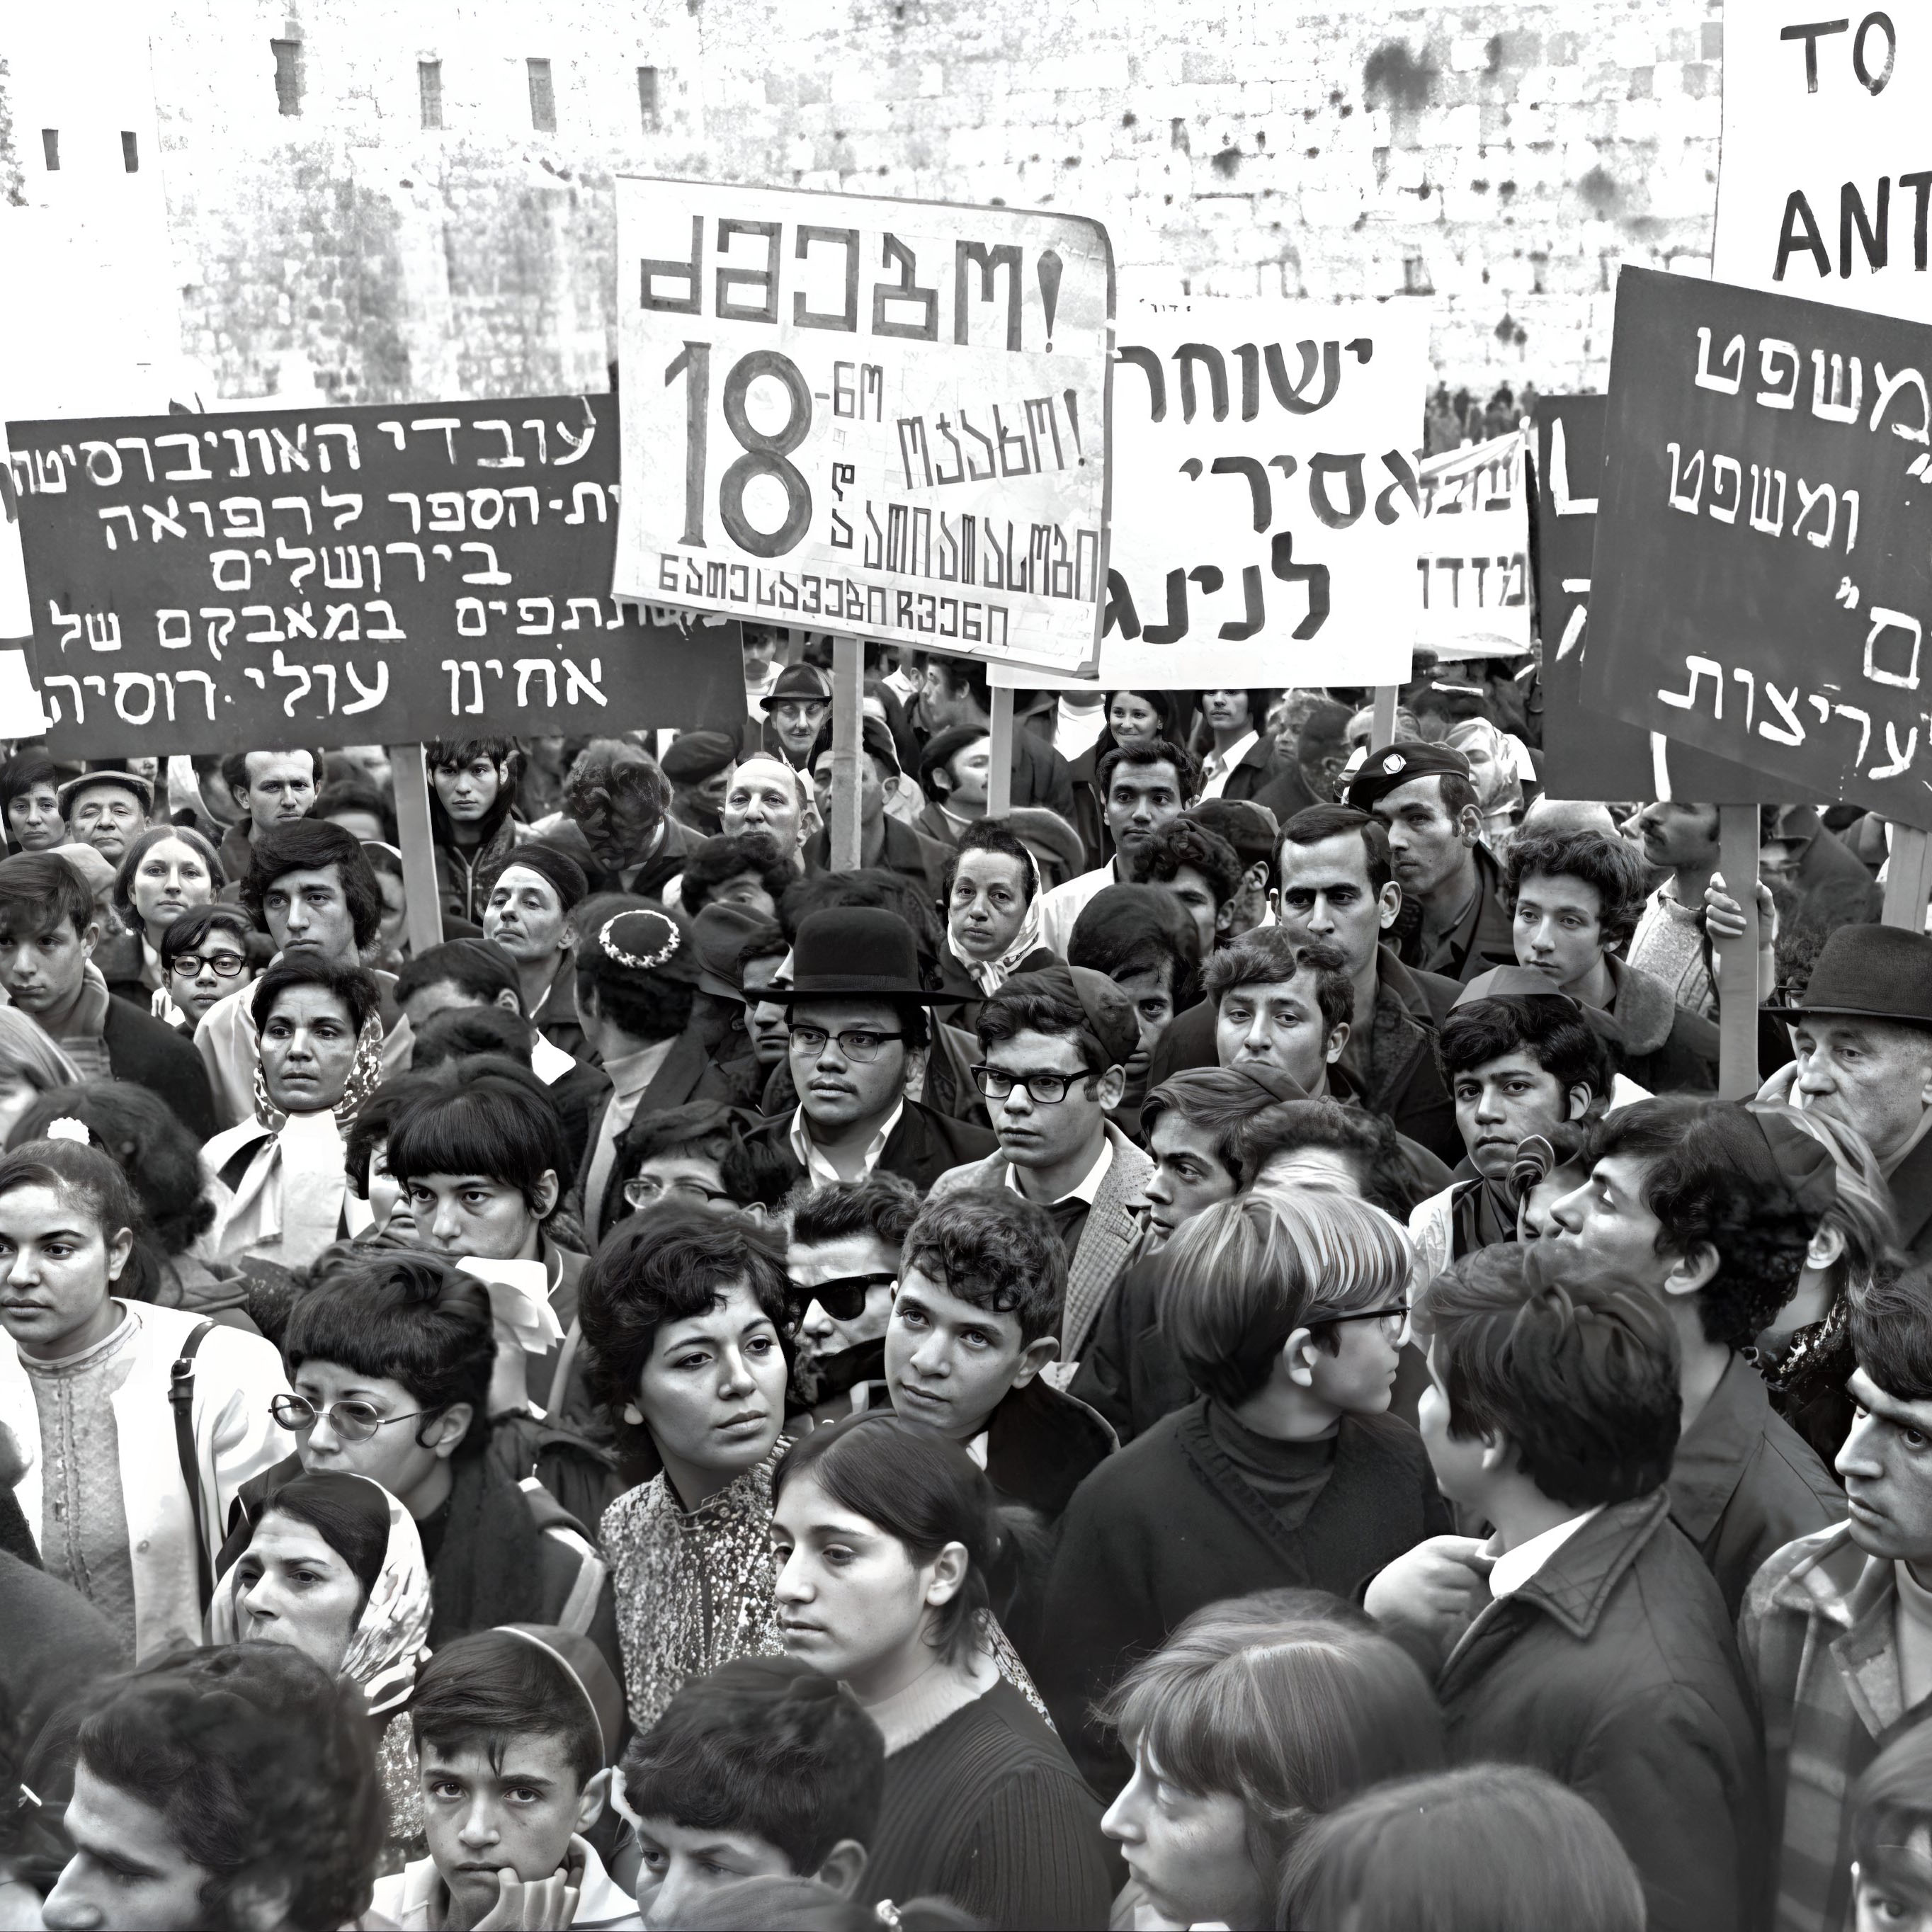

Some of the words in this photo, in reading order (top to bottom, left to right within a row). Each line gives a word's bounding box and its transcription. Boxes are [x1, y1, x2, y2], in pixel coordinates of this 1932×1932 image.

[1780, 11, 1896, 96] TO
[1772, 170, 1932, 281] ANT
[640, 215, 1064, 353] ძმებო!
[1695, 326, 1931, 446] משפט
[10, 422, 361, 497] האוניברסיטה
[99, 485, 363, 550] לרפואה
[1666, 442, 1860, 555] ומשפט
[50, 599, 122, 653] של
[155, 599, 408, 661] במאבקם
[43, 669, 217, 725] רוסיה
[244, 649, 390, 717] עולי
[441, 657, 608, 715] אחינו
